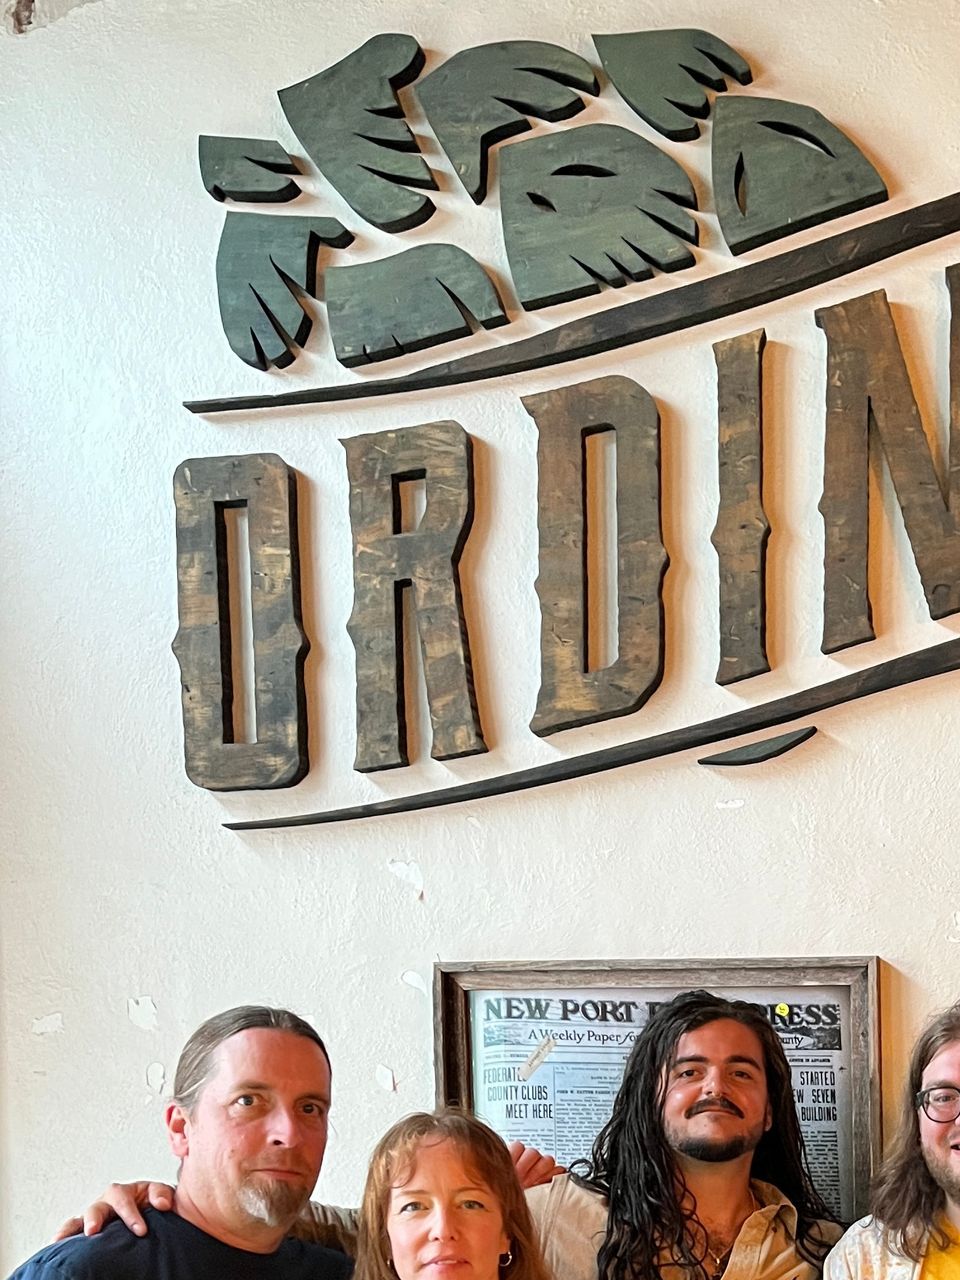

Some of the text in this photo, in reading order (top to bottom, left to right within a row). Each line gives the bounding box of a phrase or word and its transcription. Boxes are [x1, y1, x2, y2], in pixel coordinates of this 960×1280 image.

[484, 998, 553, 1021] NEW
[559, 1000, 638, 1023] PORT
[766, 1003, 838, 1027] RESS
[528, 1029, 538, 1040] A
[539, 1029, 585, 1044] Weekly
[587, 1030, 621, 1045] Paper
[618, 1031, 640, 1046] fo
[800, 1071, 835, 1086] STARTED
[487, 1085, 519, 1102] COUNTY
[521, 1085, 548, 1101] CLUBS
[505, 1103, 554, 1119] MEET HERE
[801, 1106, 837, 1122] BUILDING
